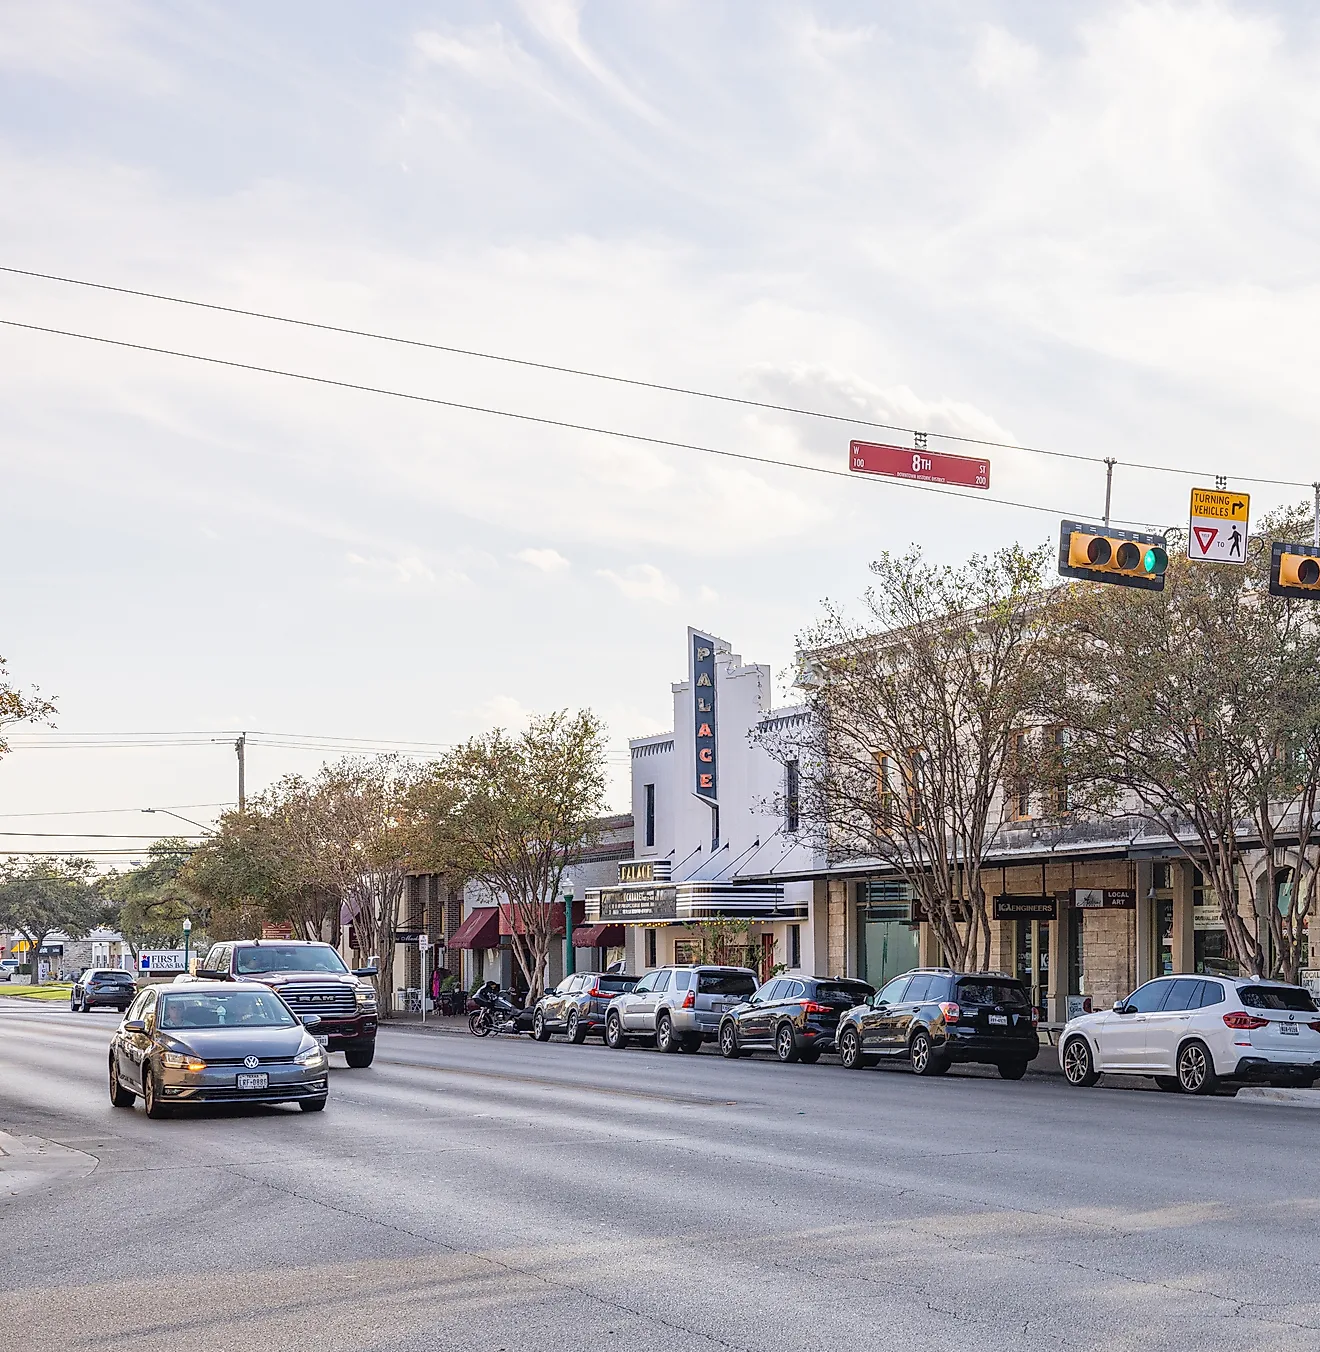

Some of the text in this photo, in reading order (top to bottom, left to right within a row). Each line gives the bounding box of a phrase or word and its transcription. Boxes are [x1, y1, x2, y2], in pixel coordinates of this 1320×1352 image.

[853, 446, 860, 455] W
[853, 458, 865, 468] 100
[912, 454, 932, 472] 8TH
[979, 465, 986, 474] ST
[975, 476, 987, 485] 200
[1195, 493, 1230, 505] TURNING
[1194, 505, 1228, 516] VEHICLES
[696, 646, 714, 788] PALACE
[621, 864, 652, 880] PALACE
[1112, 898, 1126, 906] ART
[151, 955, 179, 963] FIRST
